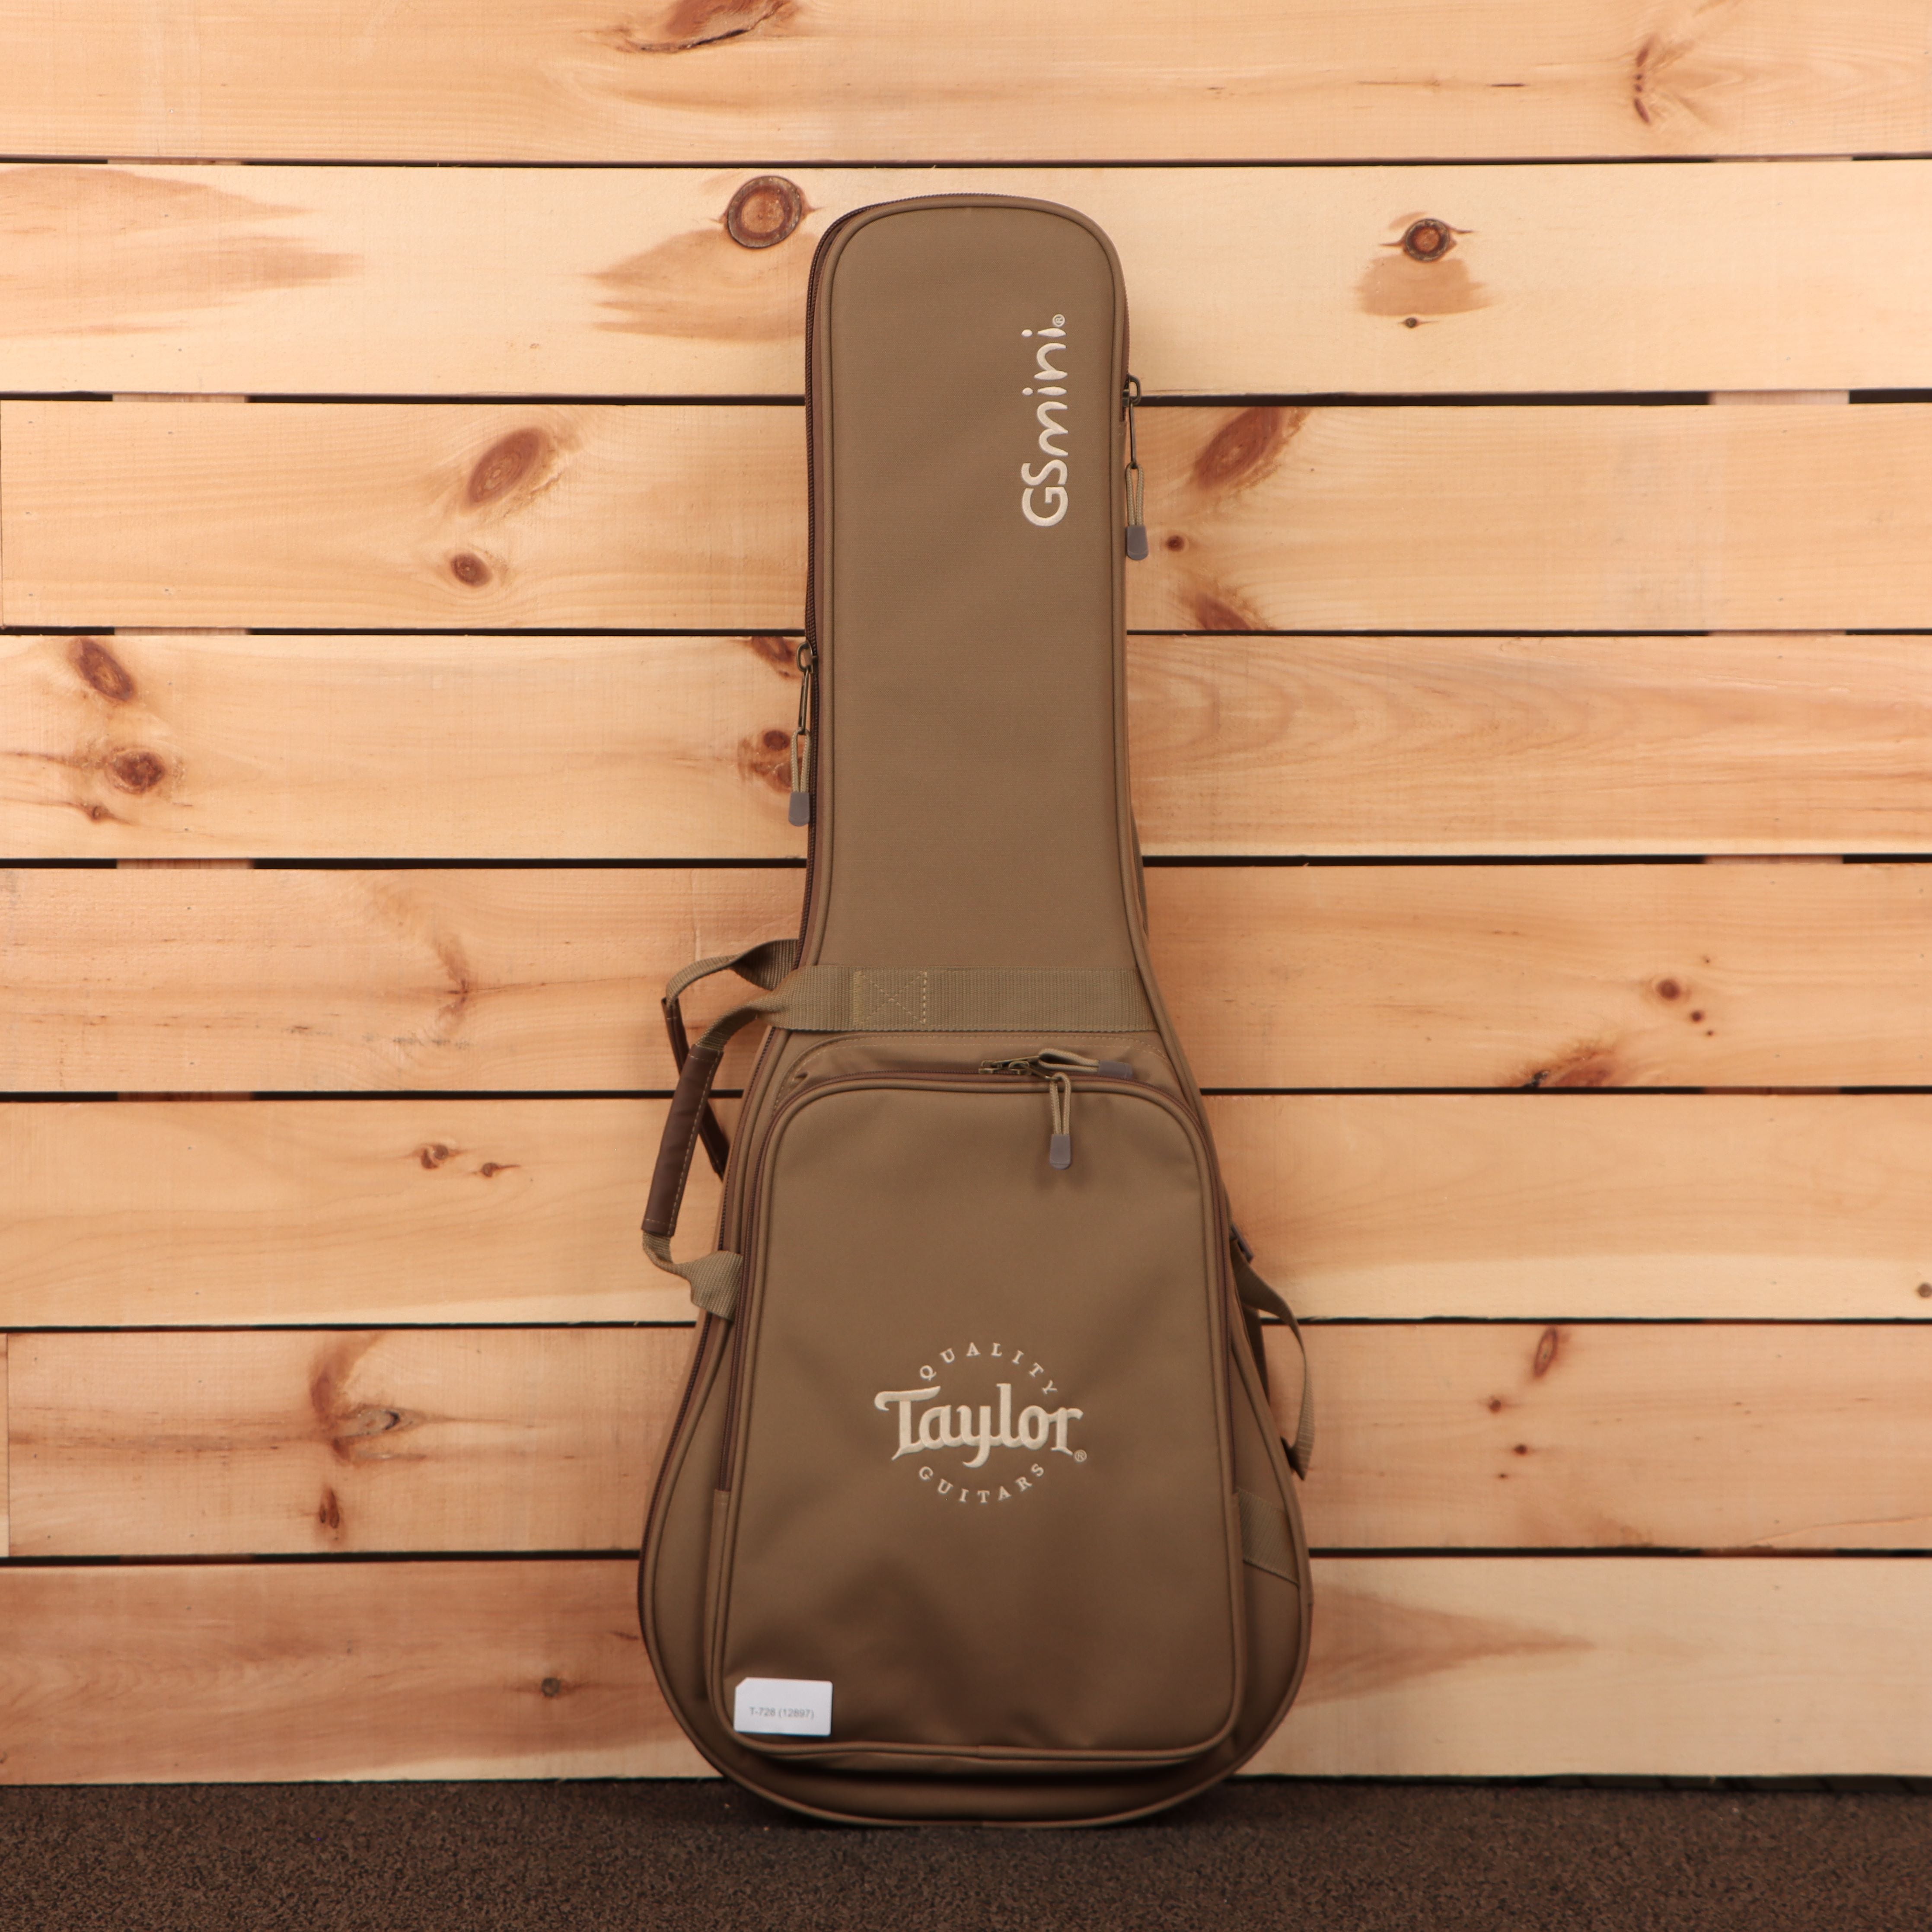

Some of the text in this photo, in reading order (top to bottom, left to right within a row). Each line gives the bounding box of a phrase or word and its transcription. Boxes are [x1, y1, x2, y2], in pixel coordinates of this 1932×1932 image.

[919, 1342, 1058, 1395] QUALITY
[918, 1463, 1045, 1504] GUITARS
[749, 1707, 776, 1717] T-728
